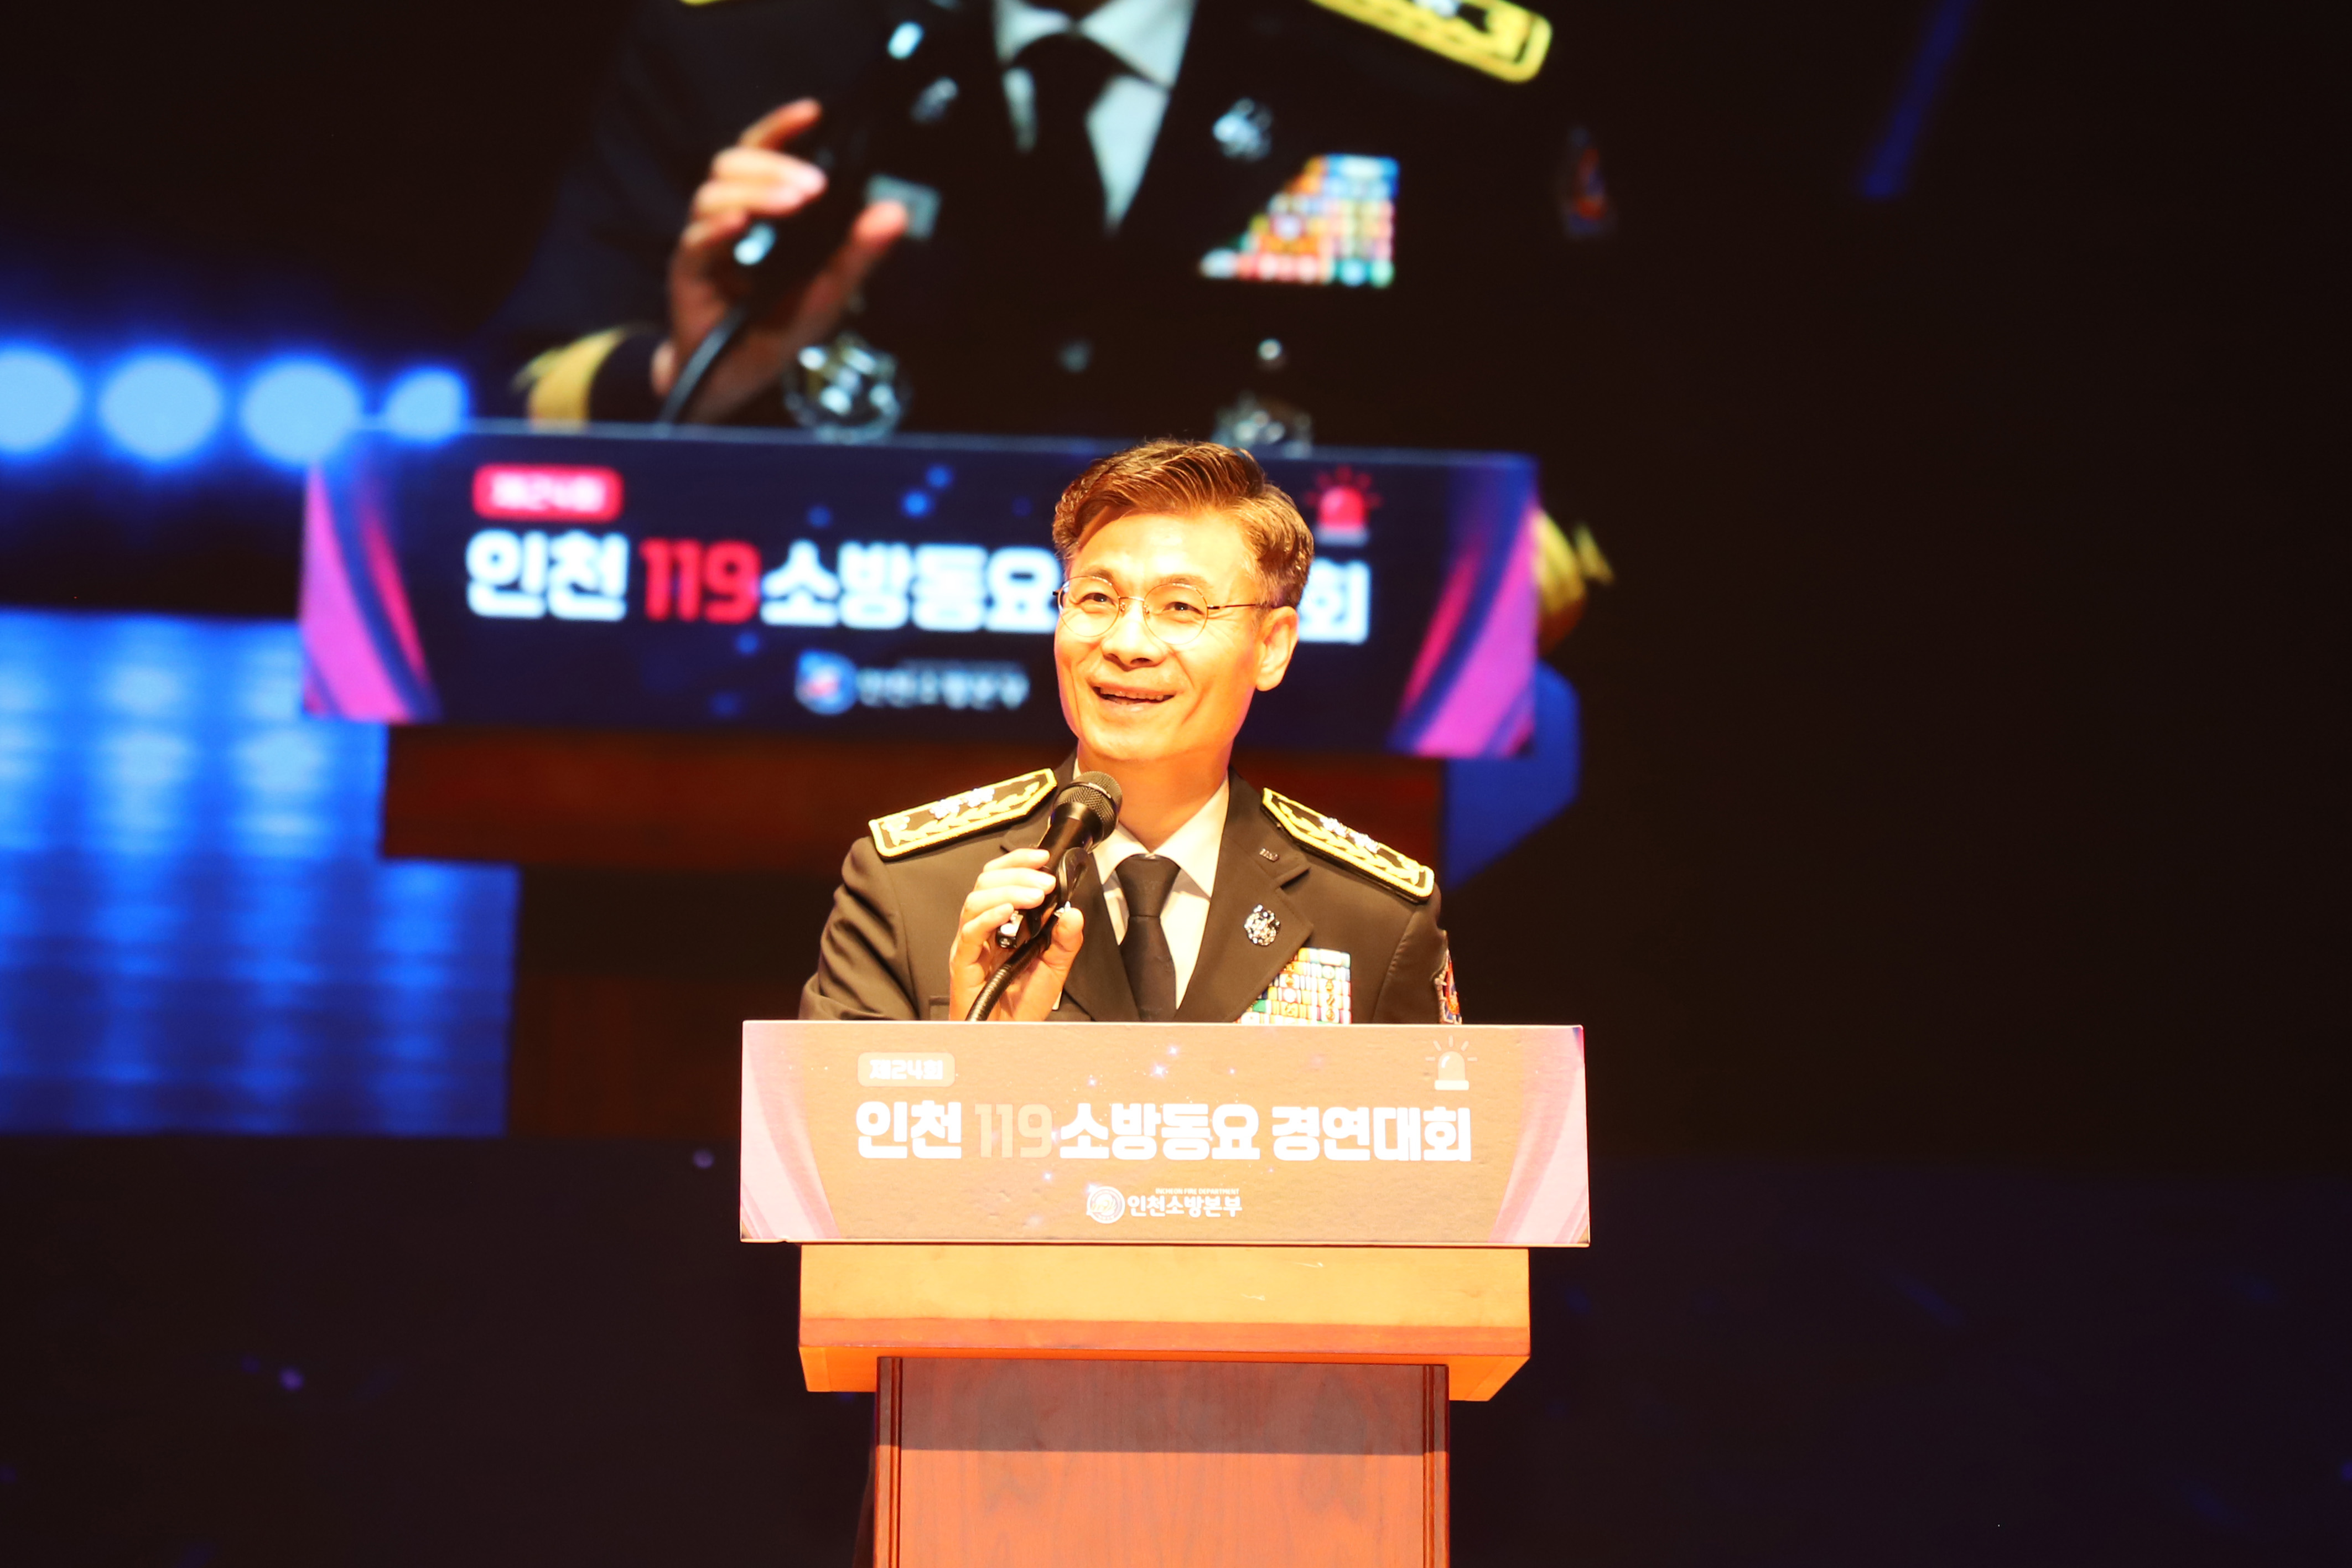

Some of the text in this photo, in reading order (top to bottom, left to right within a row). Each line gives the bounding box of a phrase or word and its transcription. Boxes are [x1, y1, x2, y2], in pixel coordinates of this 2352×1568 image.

[466, 528, 631, 621] 인천
[869, 1059, 943, 1080] 제24회
[856, 1100, 962, 1159] 인천
[1272, 1106, 1472, 1162] 경연대회
[1127, 1195, 1243, 1218] 인천소방본부
